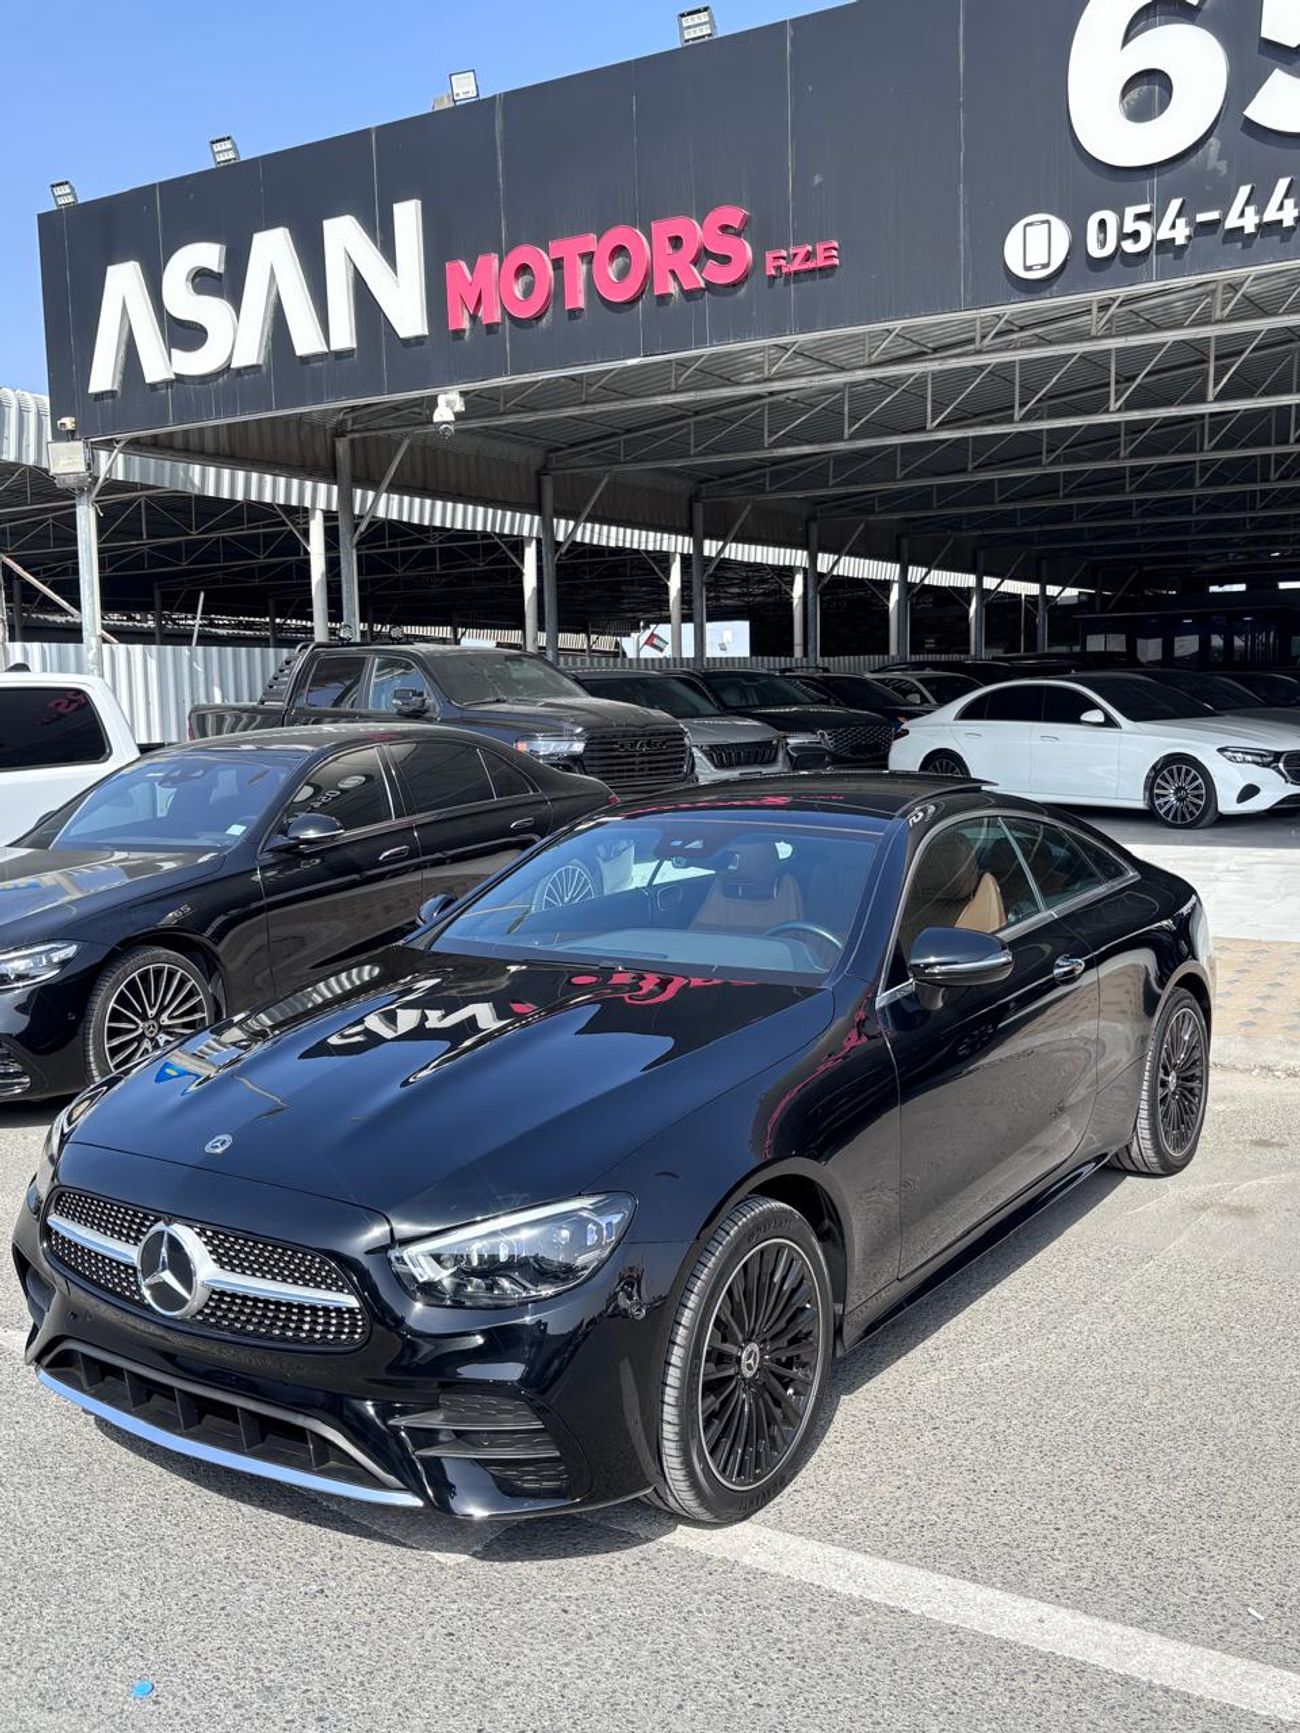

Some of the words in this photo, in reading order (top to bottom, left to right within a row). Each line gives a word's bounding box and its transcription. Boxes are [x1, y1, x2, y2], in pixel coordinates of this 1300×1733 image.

[1086, 176, 1300, 259] 054-44
[88, 199, 429, 394] ASAN
[445, 204, 753, 331] MOTORS
